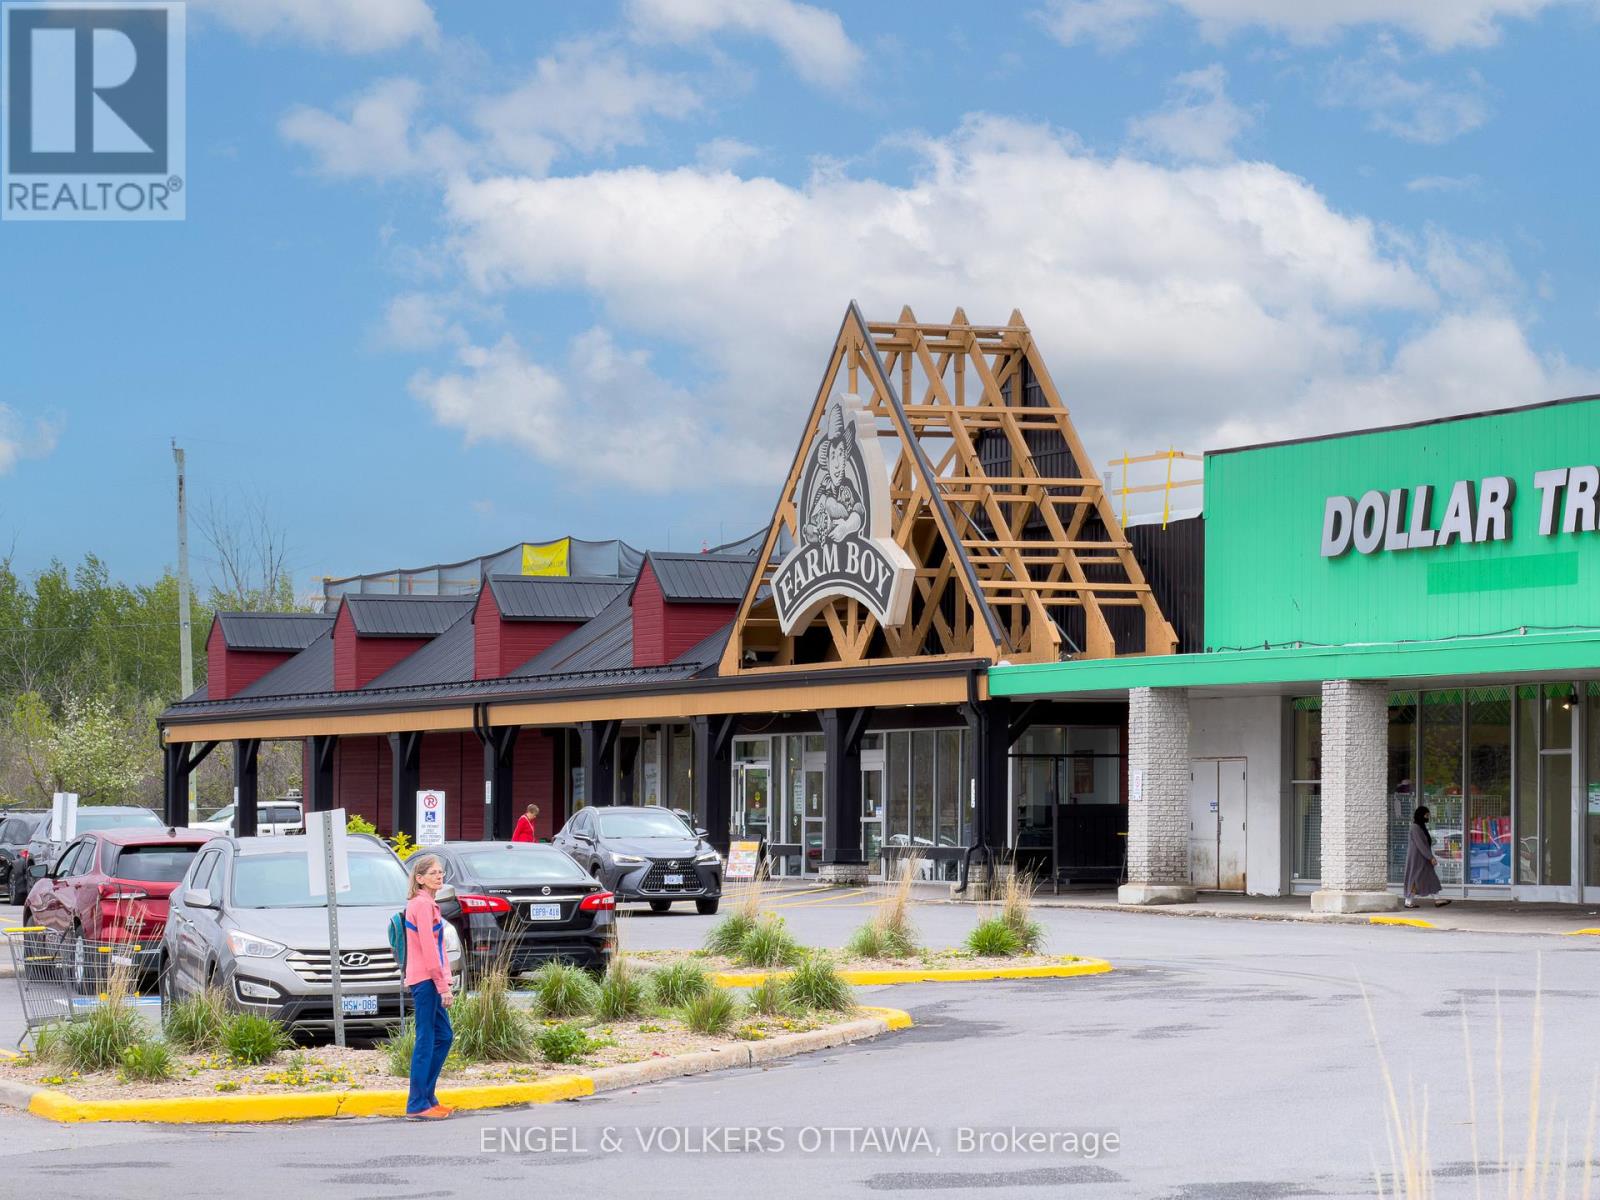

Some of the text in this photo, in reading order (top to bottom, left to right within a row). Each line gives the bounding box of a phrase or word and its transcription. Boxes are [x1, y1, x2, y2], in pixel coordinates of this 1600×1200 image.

[1320, 465, 1600, 558] DOLLAR TR
[779, 541, 891, 611] FARM BOY
